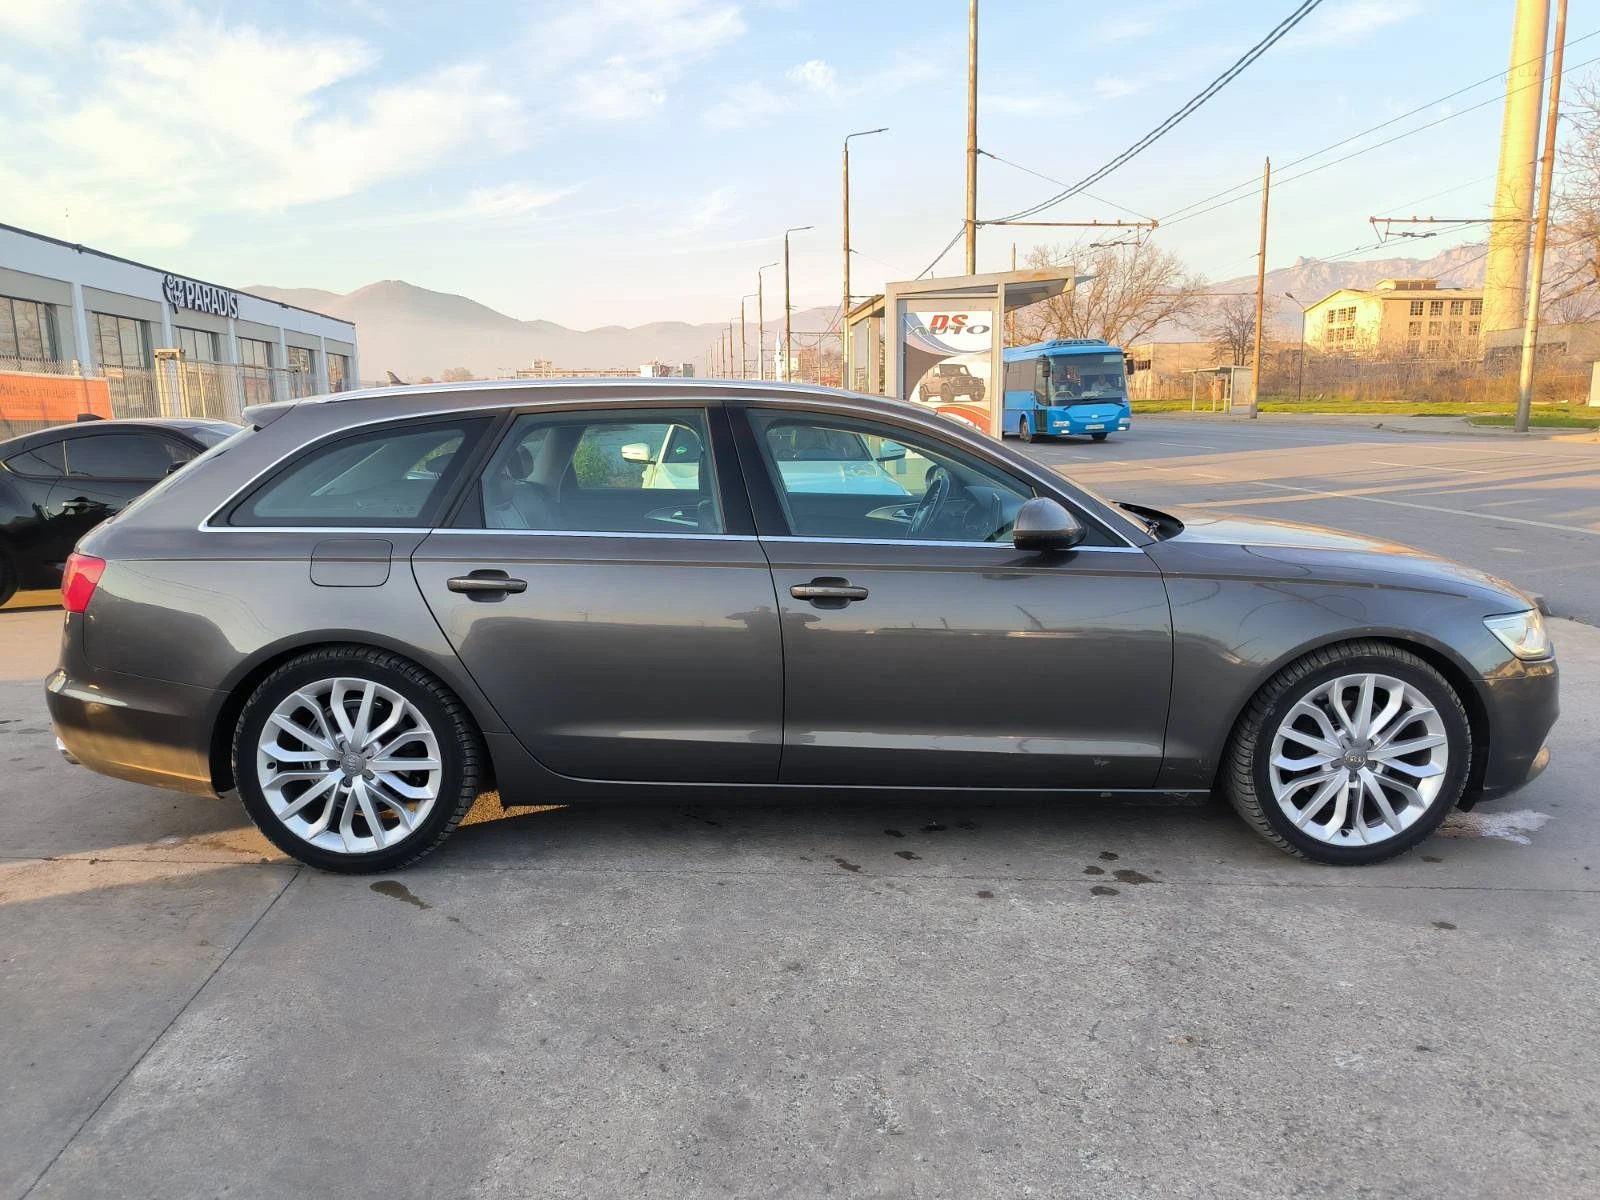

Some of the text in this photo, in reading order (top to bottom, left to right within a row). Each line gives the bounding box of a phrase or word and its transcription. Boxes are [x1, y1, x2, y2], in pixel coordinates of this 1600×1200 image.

[184, 282, 240, 319] PARADIS
[908, 325, 990, 335] AUTO
[929, 314, 968, 330] DS
